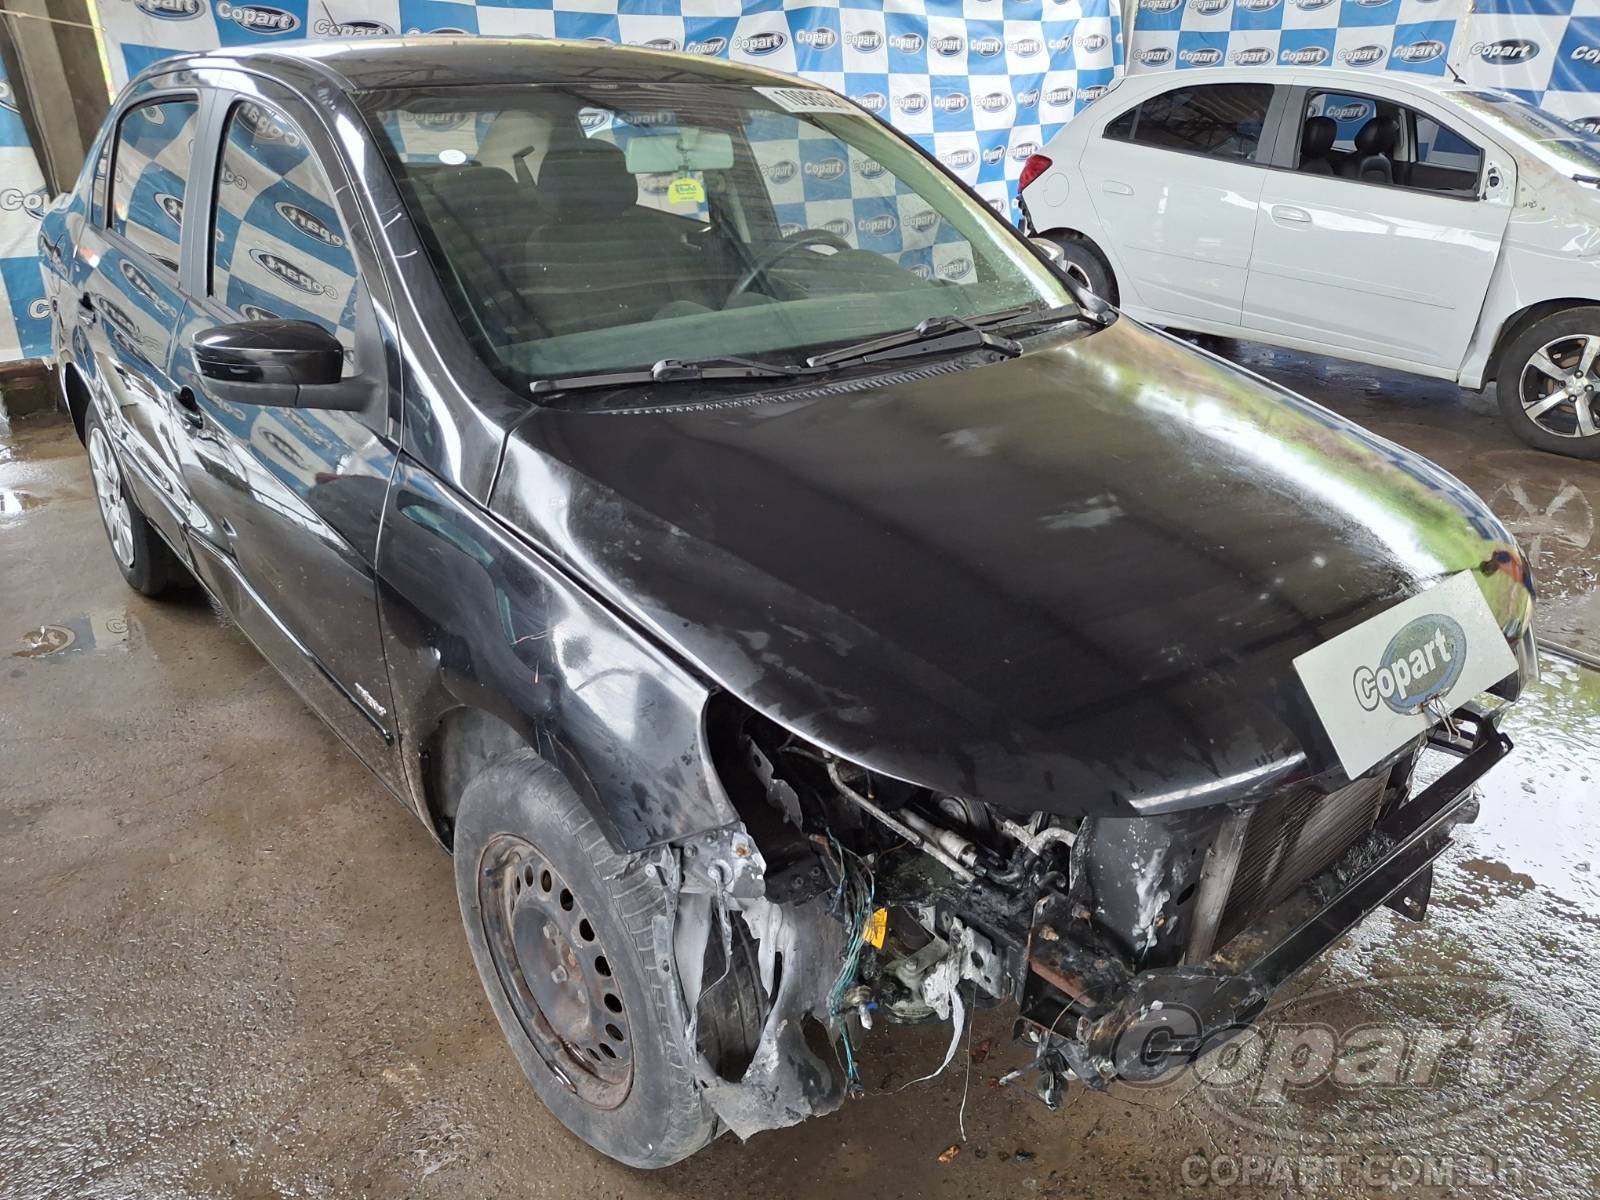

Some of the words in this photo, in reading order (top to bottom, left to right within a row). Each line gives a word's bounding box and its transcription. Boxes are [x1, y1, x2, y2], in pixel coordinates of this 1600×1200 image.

[217, 1, 290, 29] Copart
[733, 34, 780, 52] Copart
[797, 31, 834, 48] Copart
[845, 32, 882, 48] Copart
[889, 34, 920, 49] Copart
[930, 36, 962, 53] Copart
[971, 38, 1001, 53] Copart
[1007, 38, 1040, 54] Copart
[1134, 48, 1170, 62] Copart
[1179, 49, 1219, 63] Copart
[1228, 49, 1268, 63] Copart
[1280, 48, 1324, 63] Copart
[1337, 47, 1380, 64] Copart
[1392, 42, 1441, 62] Copart
[1471, 41, 1530, 58] Copart
[894, 96, 923, 111] Copart
[934, 95, 966, 110] Copart
[974, 94, 1008, 110] Copart
[1327, 104, 1365, 119] Copart
[940, 151, 972, 166] Copart
[760, 163, 793, 178] Copart
[804, 161, 840, 178] Copart
[858, 218, 892, 232] Copart
[904, 213, 935, 227] Copart
[937, 261, 968, 275] Copart
[1353, 627, 1452, 711] Copart
